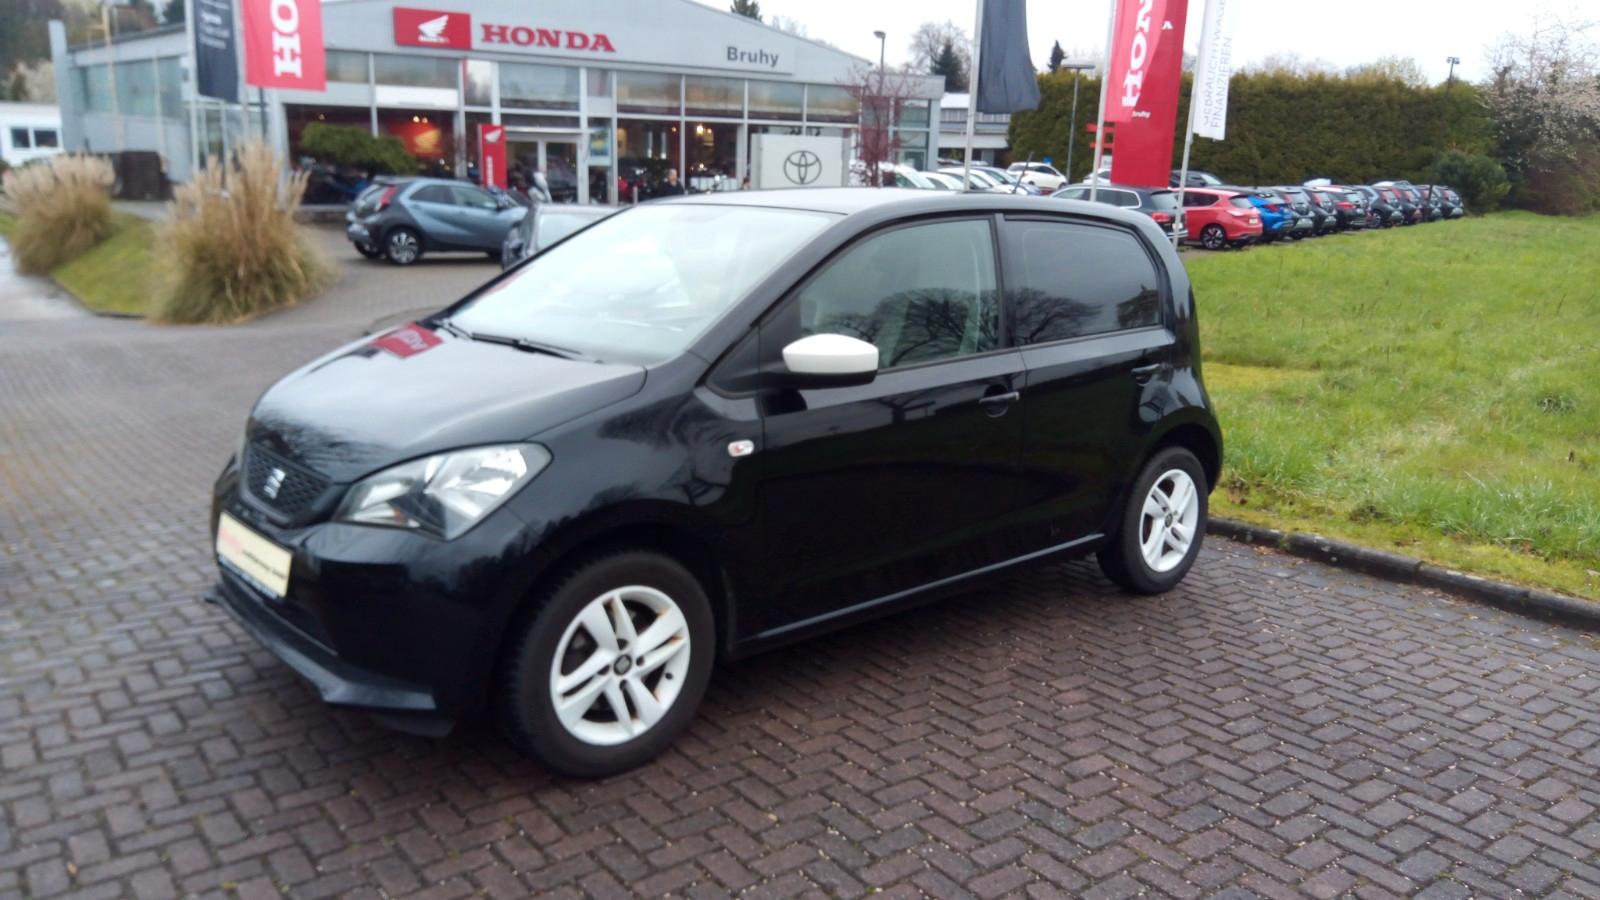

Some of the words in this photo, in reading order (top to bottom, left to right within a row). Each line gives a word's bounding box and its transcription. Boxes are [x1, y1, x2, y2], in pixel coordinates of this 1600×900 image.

[481, 24, 616, 53] HONDA
[727, 46, 779, 67] Bruhy
[1211, 37, 1233, 128] FINANZIEREN
